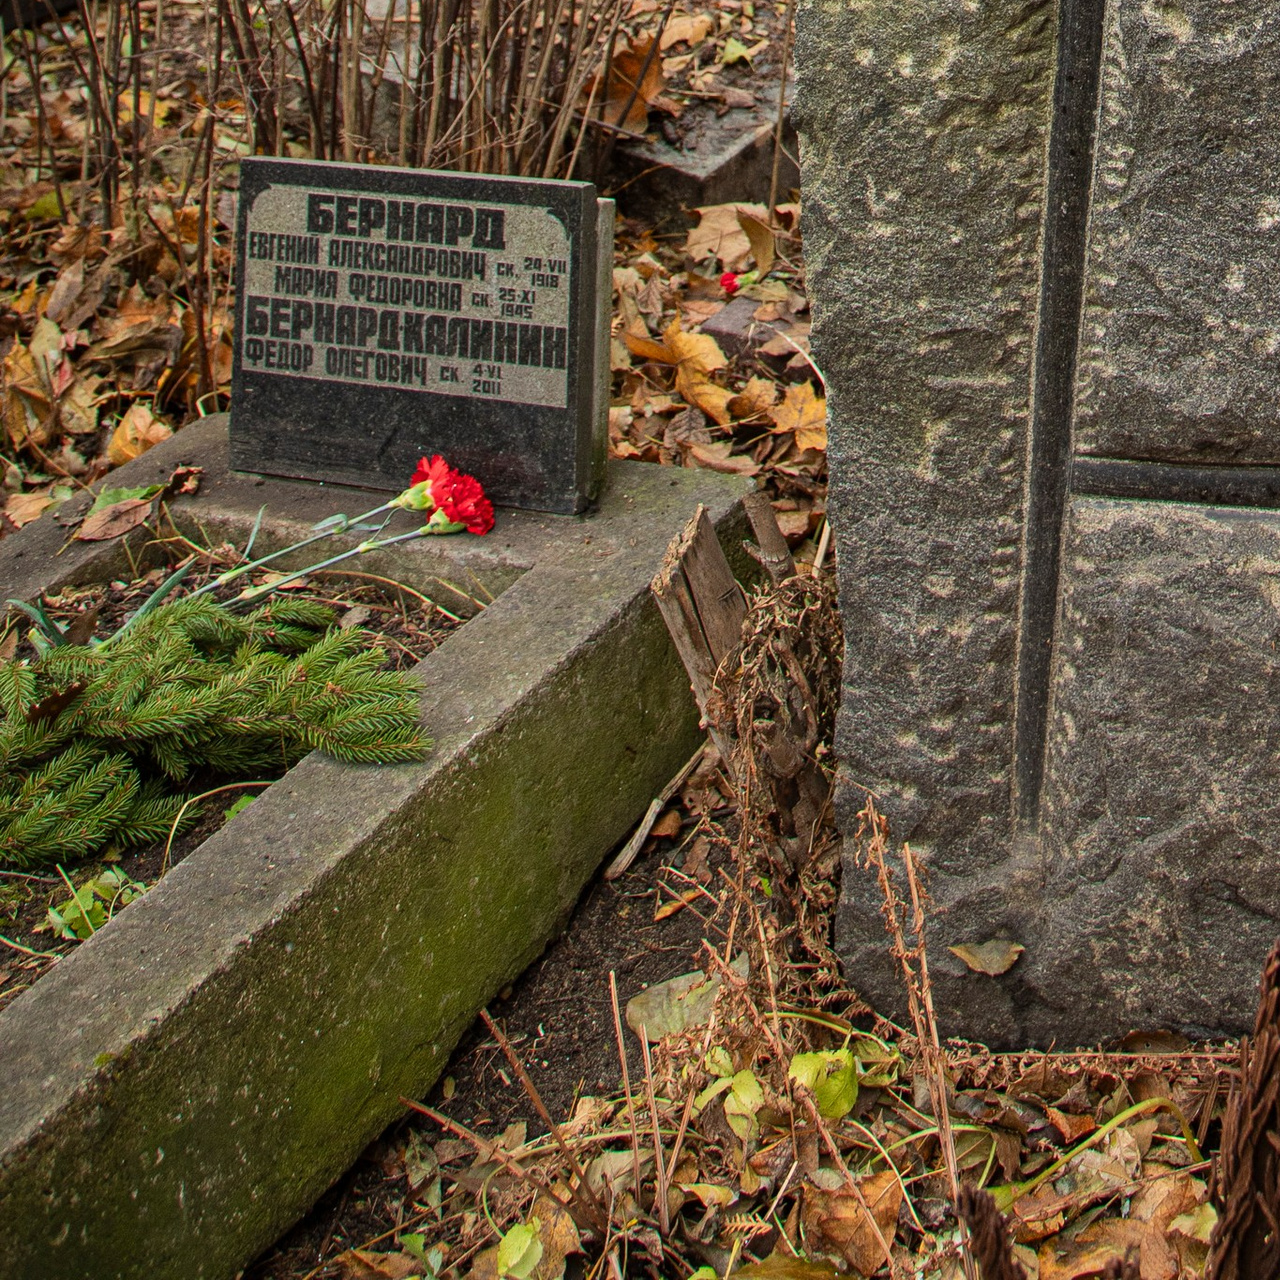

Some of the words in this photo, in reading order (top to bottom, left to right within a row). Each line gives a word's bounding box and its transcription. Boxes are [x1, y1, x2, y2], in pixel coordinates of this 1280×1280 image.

[307, 193, 505, 250] БЕРНАРД
[249, 231, 319, 264] ЕВГЕНИЙ
[328, 239, 486, 281] АЛЕКСАНДРОВИЧ
[274, 265, 338, 298] МАРИЯ
[349, 272, 462, 312] ФЕДОРОВНА
[531, 272, 559, 288] 1918
[501, 303, 533, 319] 1945
[245, 338, 313, 372] ФЕДОР
[325, 346, 427, 386] ОЛЕГОВИЧ
[473, 379, 501, 395] 2011
